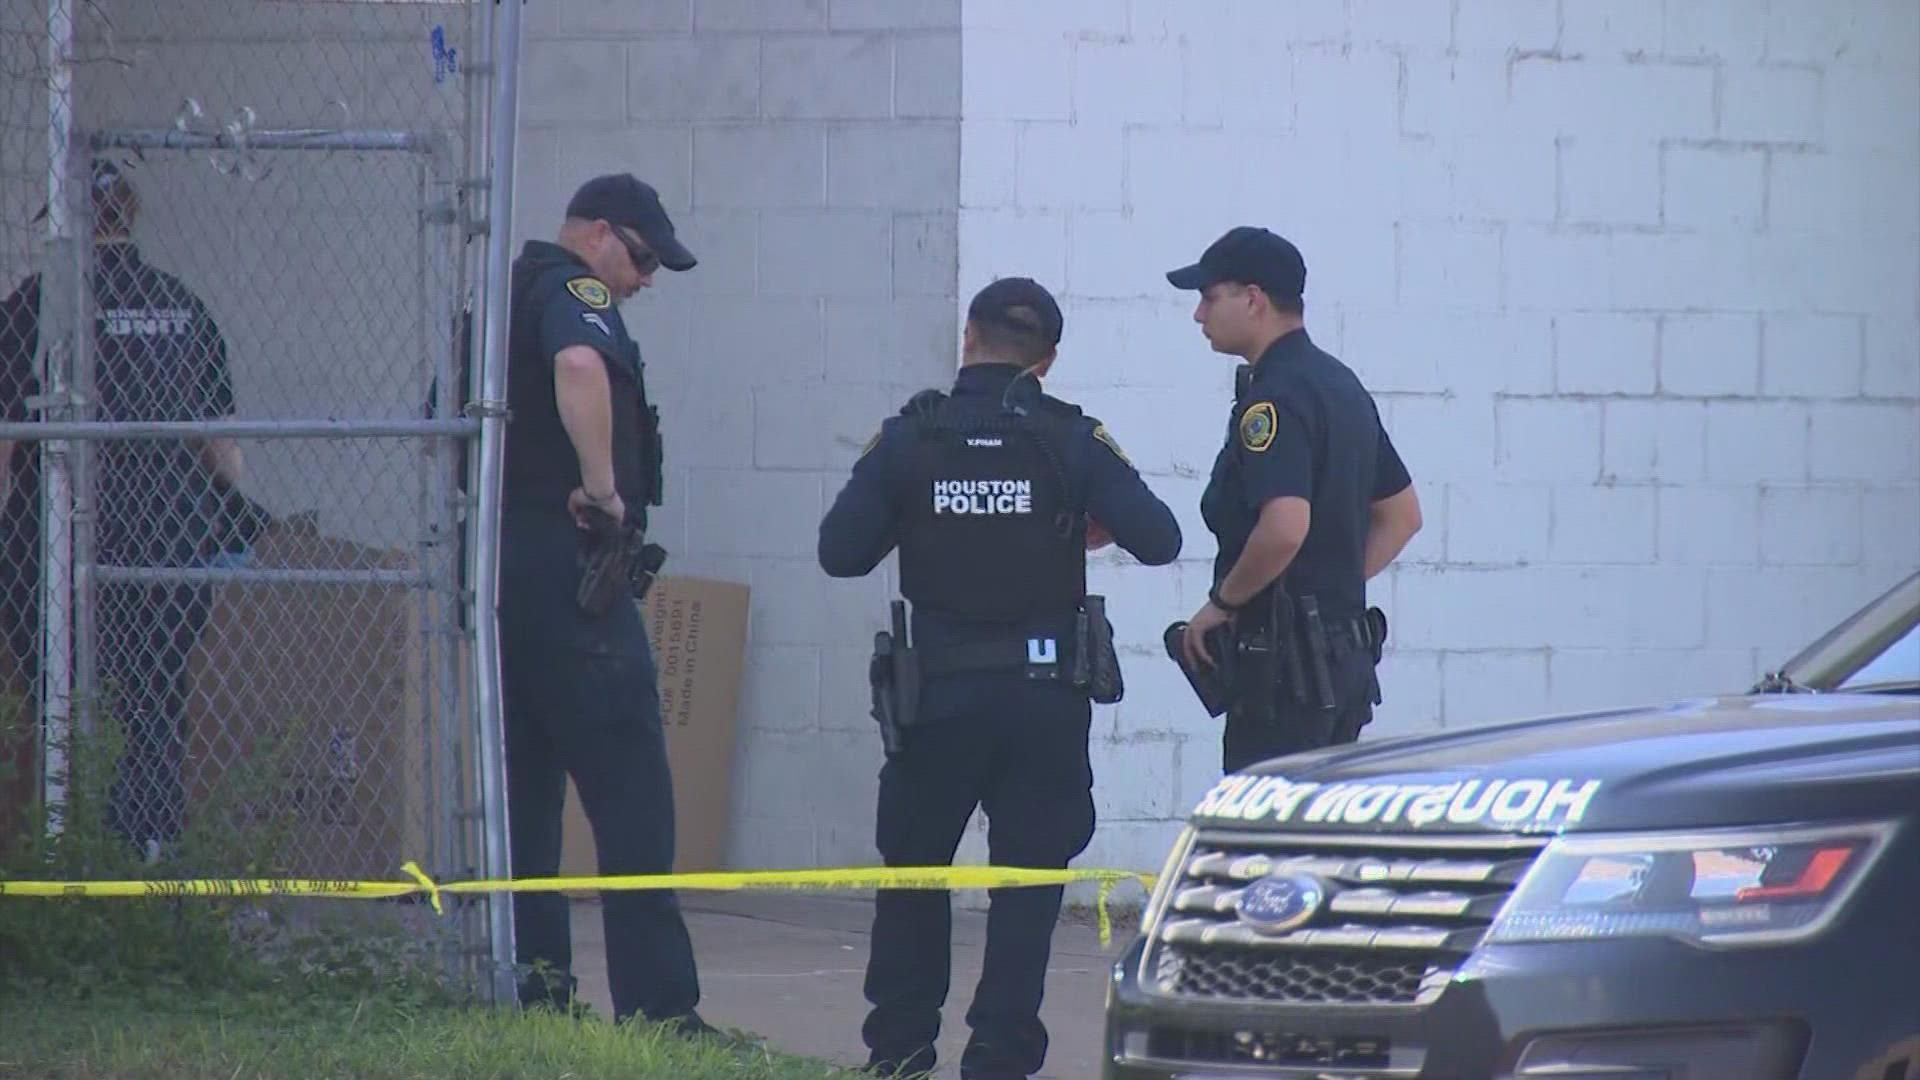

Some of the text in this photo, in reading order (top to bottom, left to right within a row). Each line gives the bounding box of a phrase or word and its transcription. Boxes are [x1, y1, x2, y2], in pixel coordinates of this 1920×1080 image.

[934, 480, 1031, 495] HOUSTON
[934, 495, 1032, 514] POLICE
[677, 601, 702, 727] Made in China
